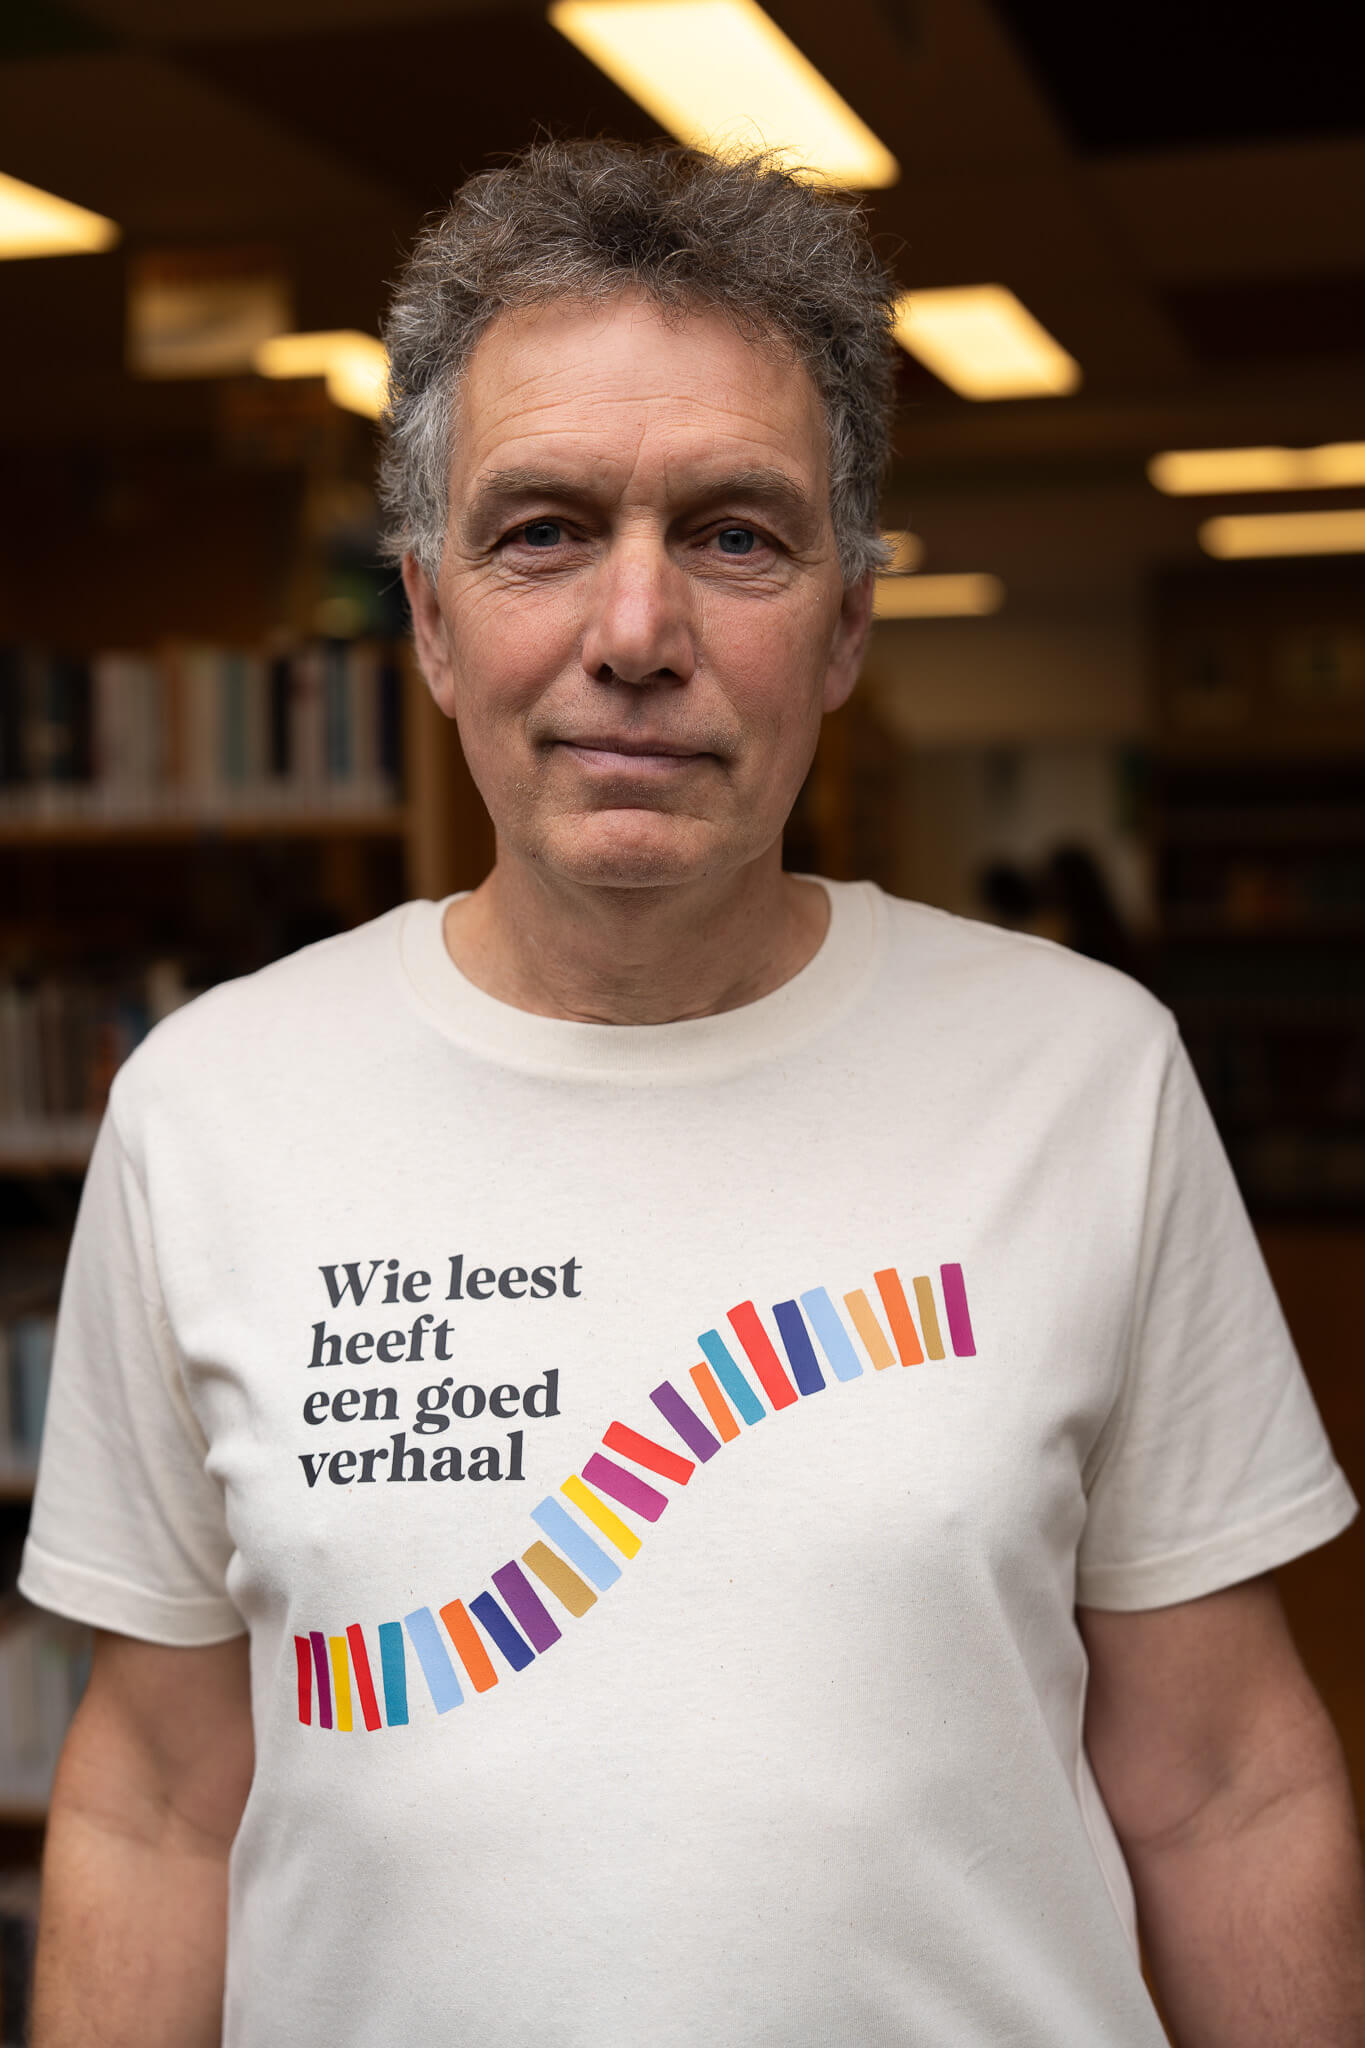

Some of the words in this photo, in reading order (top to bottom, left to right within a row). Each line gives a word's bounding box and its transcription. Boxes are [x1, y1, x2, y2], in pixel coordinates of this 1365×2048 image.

[318, 1259, 432, 1308] Wie
[445, 1254, 583, 1303] leest
[307, 1314, 455, 1369] heeft
[303, 1387, 400, 1426] een
[412, 1368, 561, 1435] goed
[297, 1430, 526, 1488] verhaal
